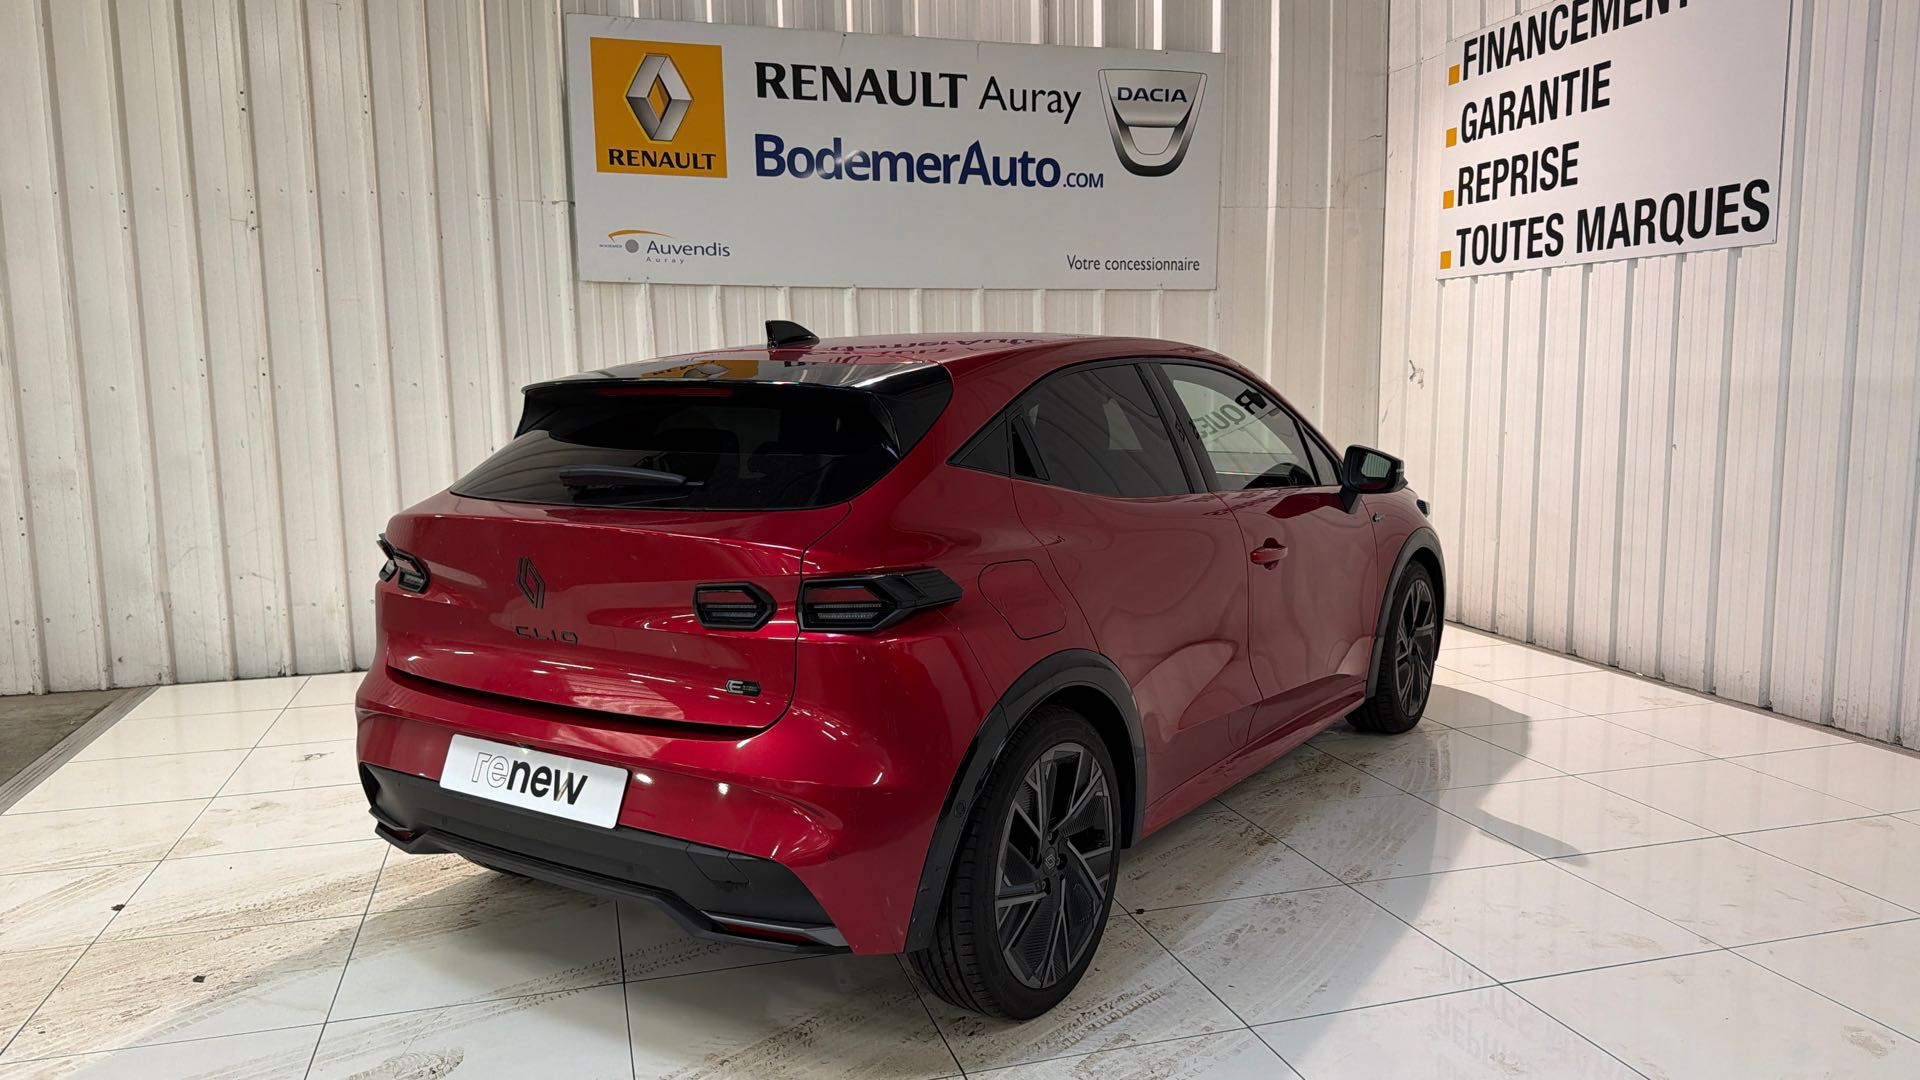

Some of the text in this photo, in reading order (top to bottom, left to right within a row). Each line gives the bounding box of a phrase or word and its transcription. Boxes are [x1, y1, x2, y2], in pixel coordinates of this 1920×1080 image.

[1463, 0, 1688, 81] FINANCEME
[755, 62, 1081, 125] RENAULT Auray
[1116, 85, 1188, 104] DACIA
[1461, 60, 1612, 144] GARANTIE
[608, 147, 717, 171] RENAULT
[1458, 141, 1580, 207] REPRISE
[1456, 178, 1770, 267] TOUTES MARQUES
[646, 240, 731, 257] Auvendis
[646, 256, 685, 264] Auray
[1067, 254, 1200, 271] Votre concessionnaire
[515, 626, 579, 646] CLIO
[471, 752, 588, 805] renew
